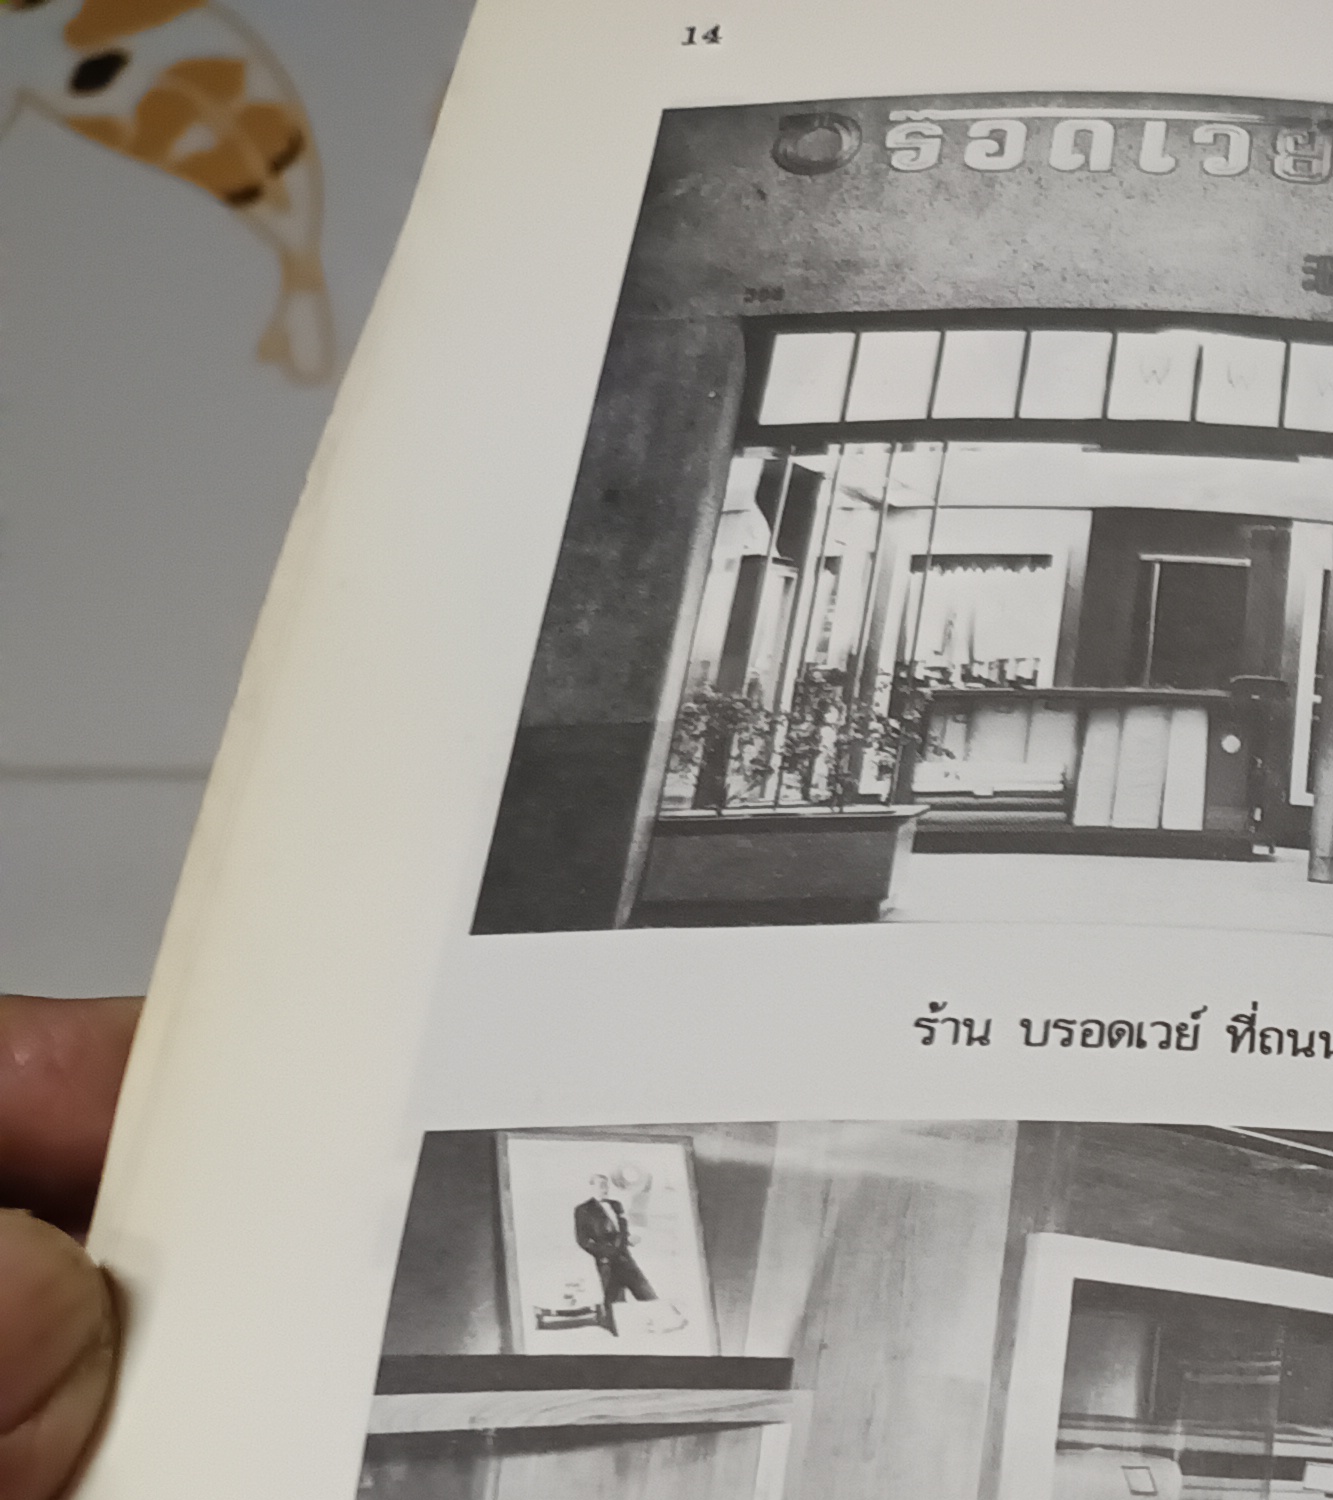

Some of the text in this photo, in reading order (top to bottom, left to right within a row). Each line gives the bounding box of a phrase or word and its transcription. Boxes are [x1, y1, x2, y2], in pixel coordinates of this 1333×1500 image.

[680, 23, 721, 47] 14
[912, 999, 993, 1048] ร้าน
[1018, 1004, 1210, 1053] บรอดเวย์
